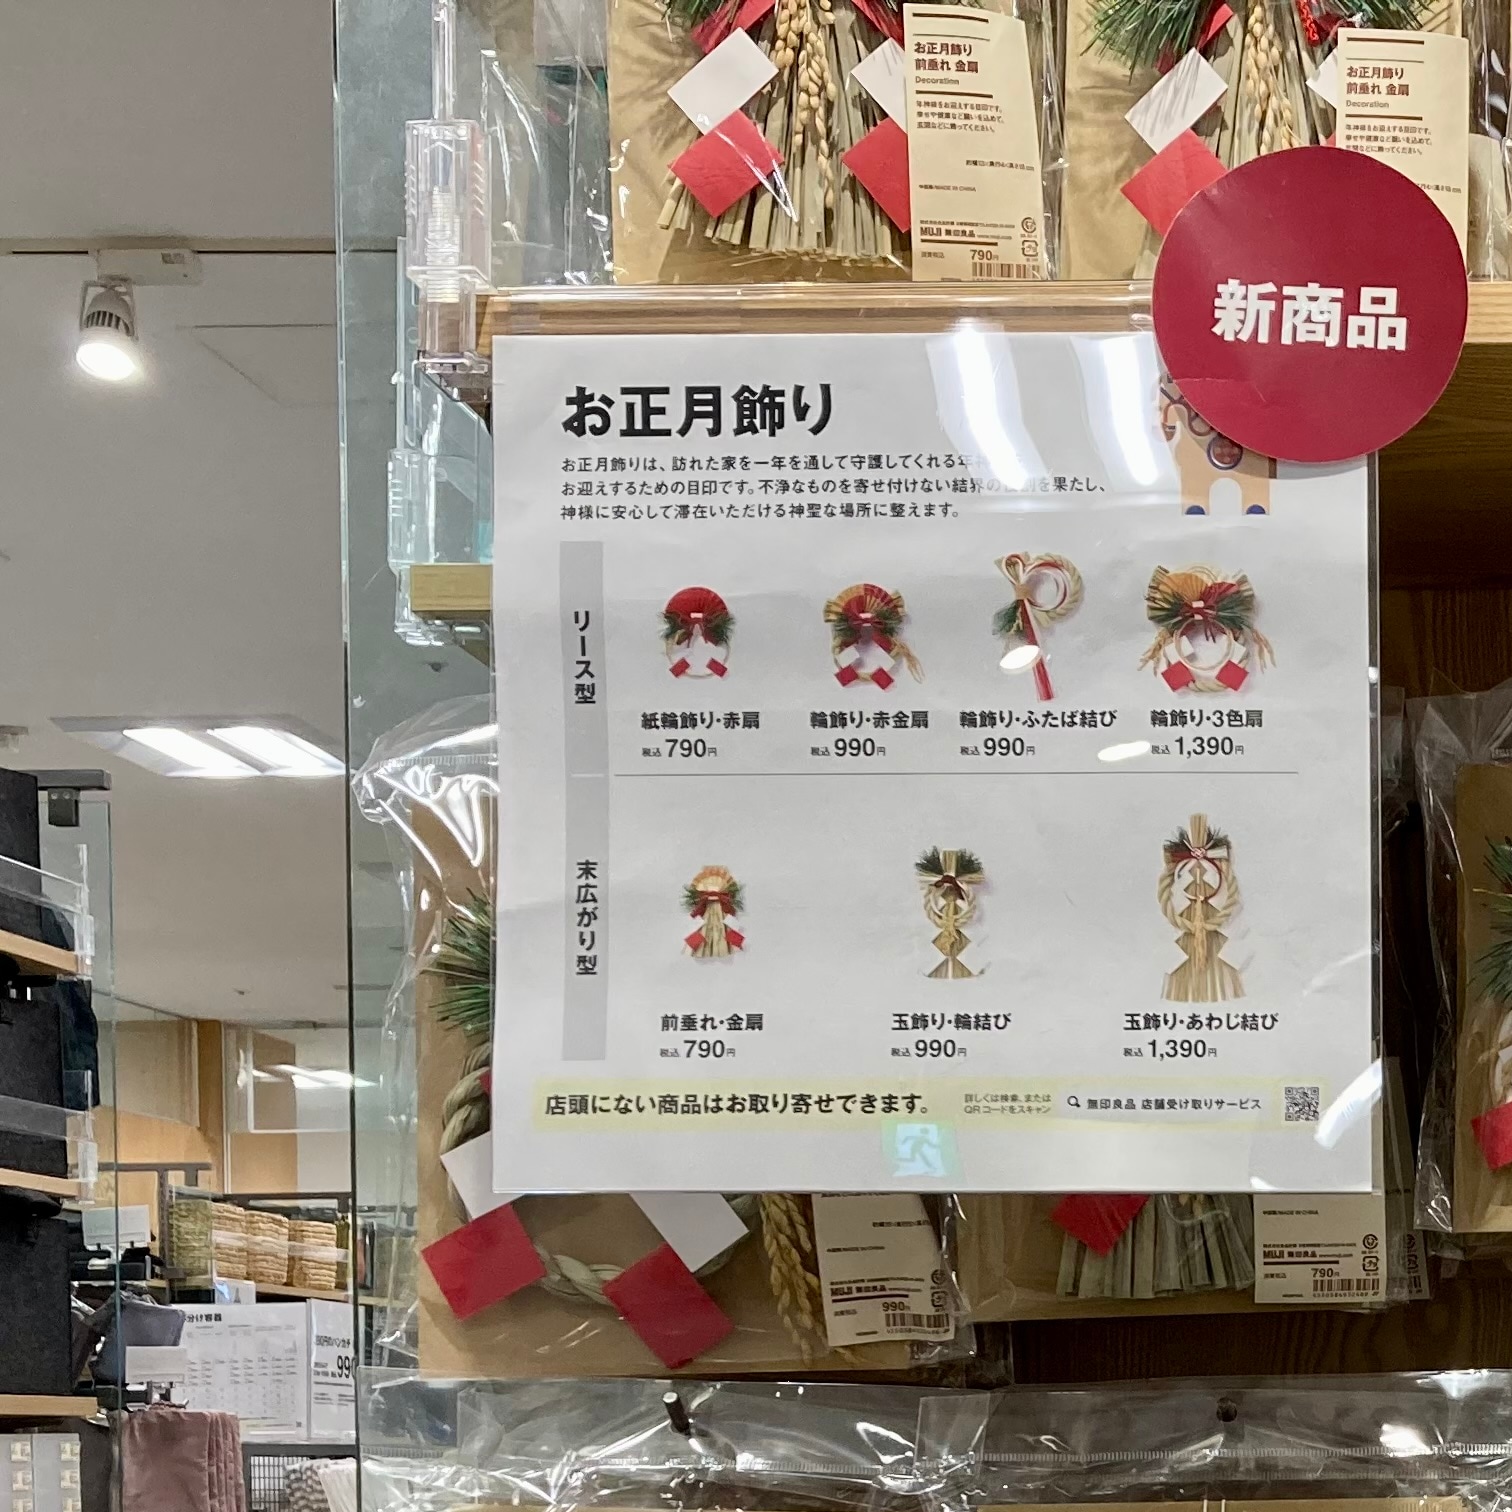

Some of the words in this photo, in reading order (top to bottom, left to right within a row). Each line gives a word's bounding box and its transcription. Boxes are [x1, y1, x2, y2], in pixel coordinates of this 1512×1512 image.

[914, 42, 973, 56] お正月飾り
[915, 76, 960, 85] Decoration
[1346, 66, 1404, 79] お正月飾り
[1346, 100, 1389, 109] Decoration
[920, 227, 942, 237] MUJI
[1211, 278, 1408, 351] 新商品
[560, 383, 834, 437] お正月飾り
[561, 454, 1023, 473] お正月飾りは、訪れた家を一年を通して守護してくれる年
[561, 476, 1106, 496] お迎えするための目印です。不浄なものを寄せ付けない結界の割を果たし、
[560, 502, 959, 520] 神様に安心して滞在いただける神聖な場所に整えます。
[573, 609, 596, 705] リース型
[641, 710, 761, 730] 紙輪飾り・赤扇
[810, 710, 929, 729] 輪飾り・赤金扇
[959, 710, 1117, 729] 輪飾り・ふたば結び
[1150, 710, 1263, 729] 輪飾り・3色扇
[575, 859, 598, 976] 末広がり型
[661, 1013, 764, 1032] 前垂れ・金扇
[891, 1013, 1012, 1032] 玉飾り・輪結び
[1123, 1012, 1279, 1031] 玉飾り・あわじ結び
[545, 1093, 928, 1115] 店頭にない商品はお取り寄せできます。
[1087, 1098, 1136, 1110] 無印良品
[1141, 1098, 1262, 1110] 店舗受け取りサービス
